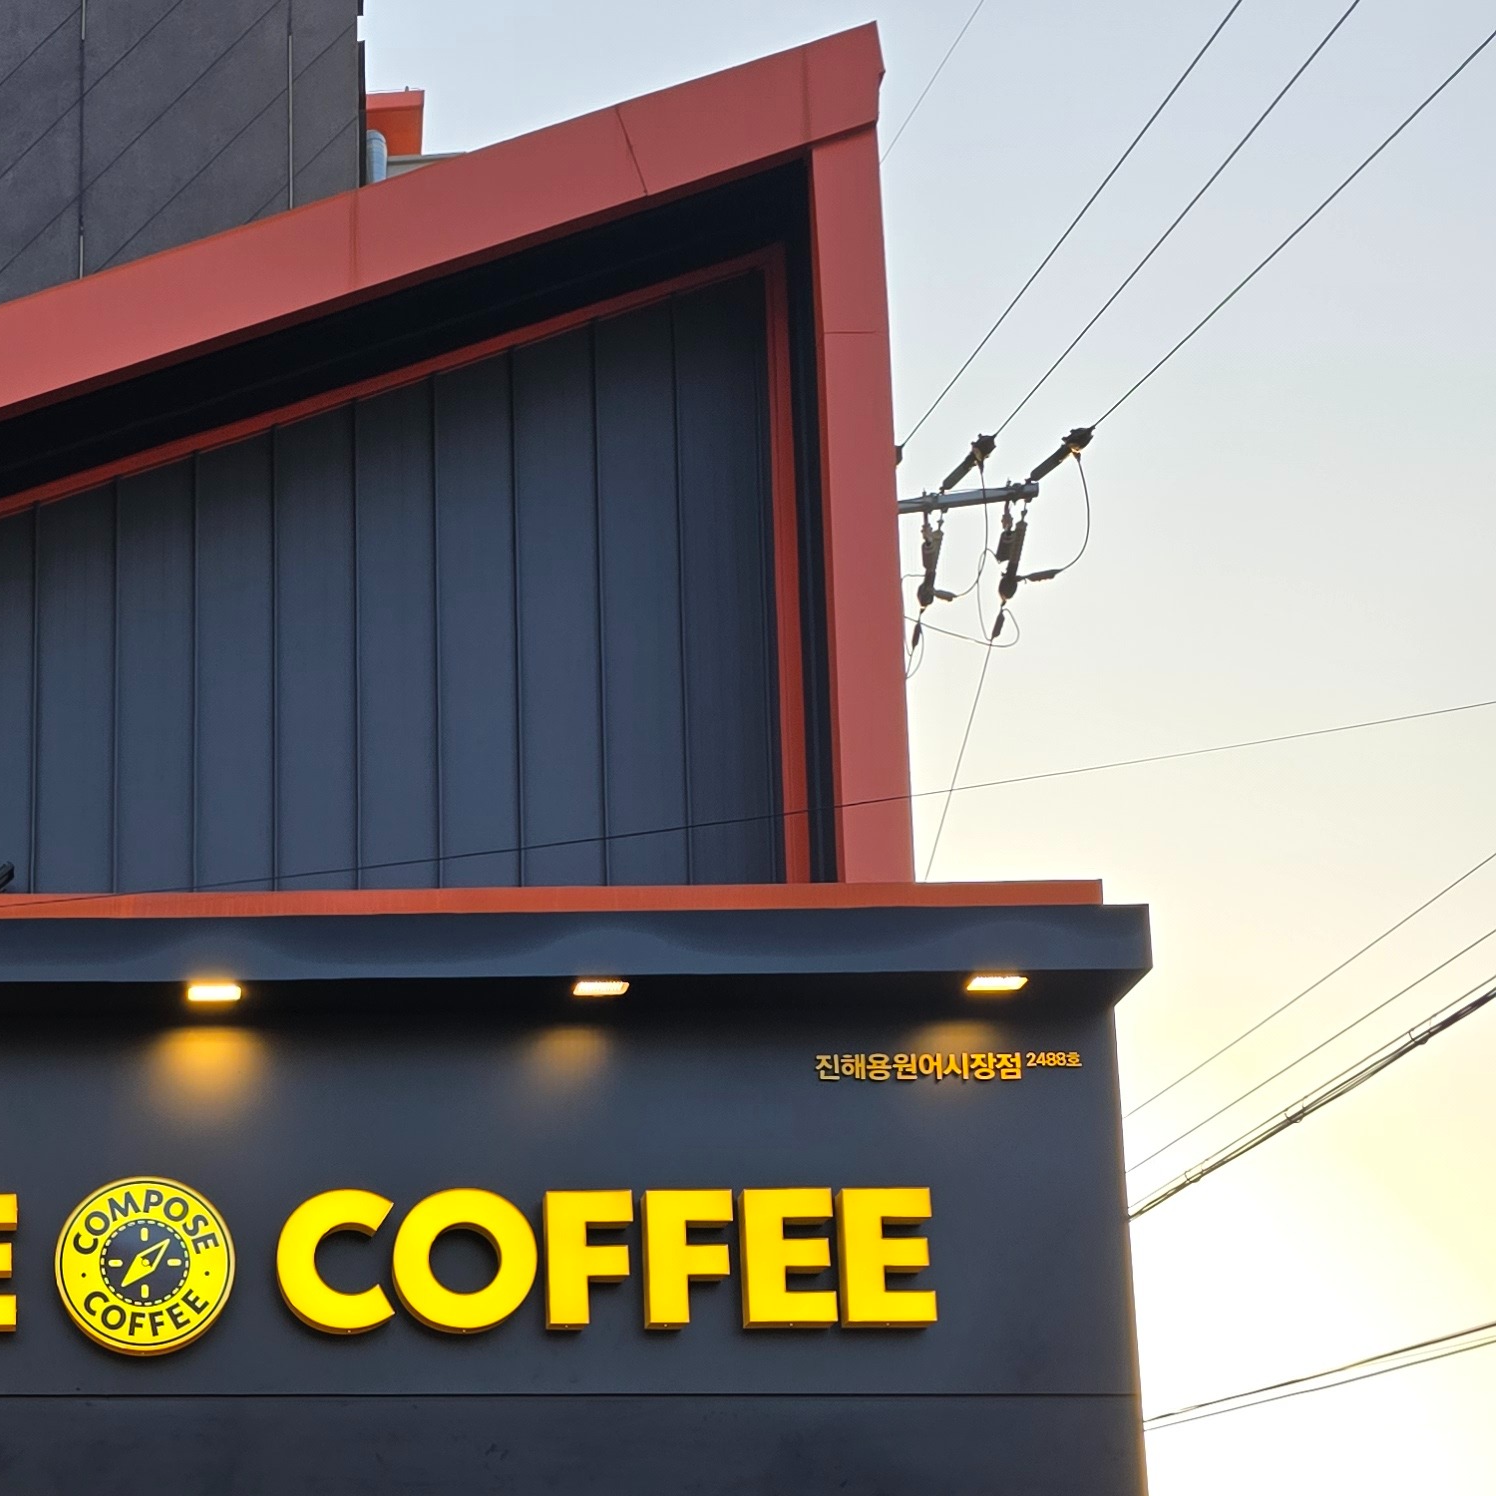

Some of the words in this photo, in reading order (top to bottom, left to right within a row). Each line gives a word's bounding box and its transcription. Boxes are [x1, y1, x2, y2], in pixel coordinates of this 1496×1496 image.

[815, 1052, 1021, 1081] 진해용원어시장점
[1026, 1052, 1082, 1068] 2488호
[71, 1187, 222, 1257] COMPOSE
[276, 1186, 938, 1336] COFFEE
[81, 1286, 208, 1338] COFFEE
